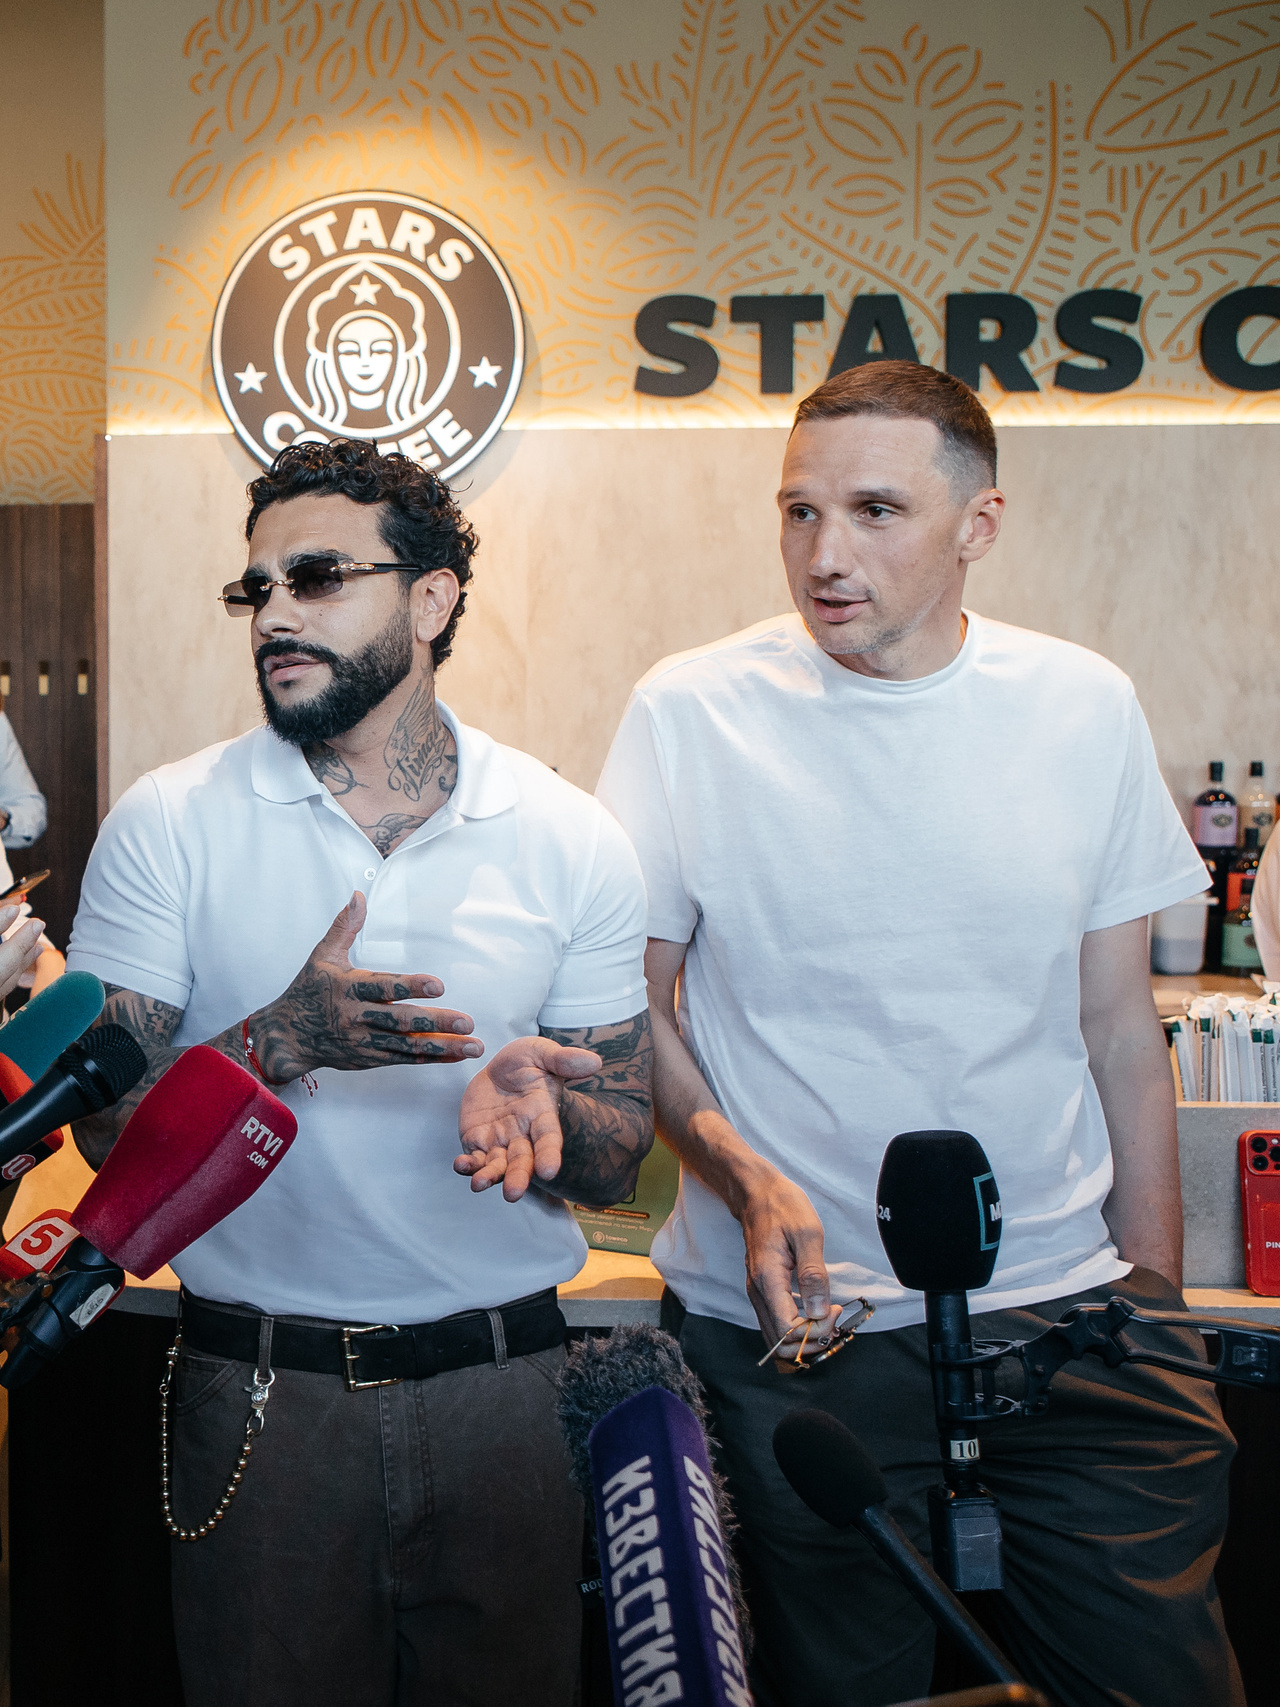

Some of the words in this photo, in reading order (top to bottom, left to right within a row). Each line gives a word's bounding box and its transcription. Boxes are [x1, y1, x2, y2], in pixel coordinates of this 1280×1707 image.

[268, 207, 475, 282] STARS
[634, 288, 1144, 398] STARS
[263, 408, 474, 468] CEE
[20, 1223, 64, 1256] 5
[956, 1441, 977, 1458] 10
